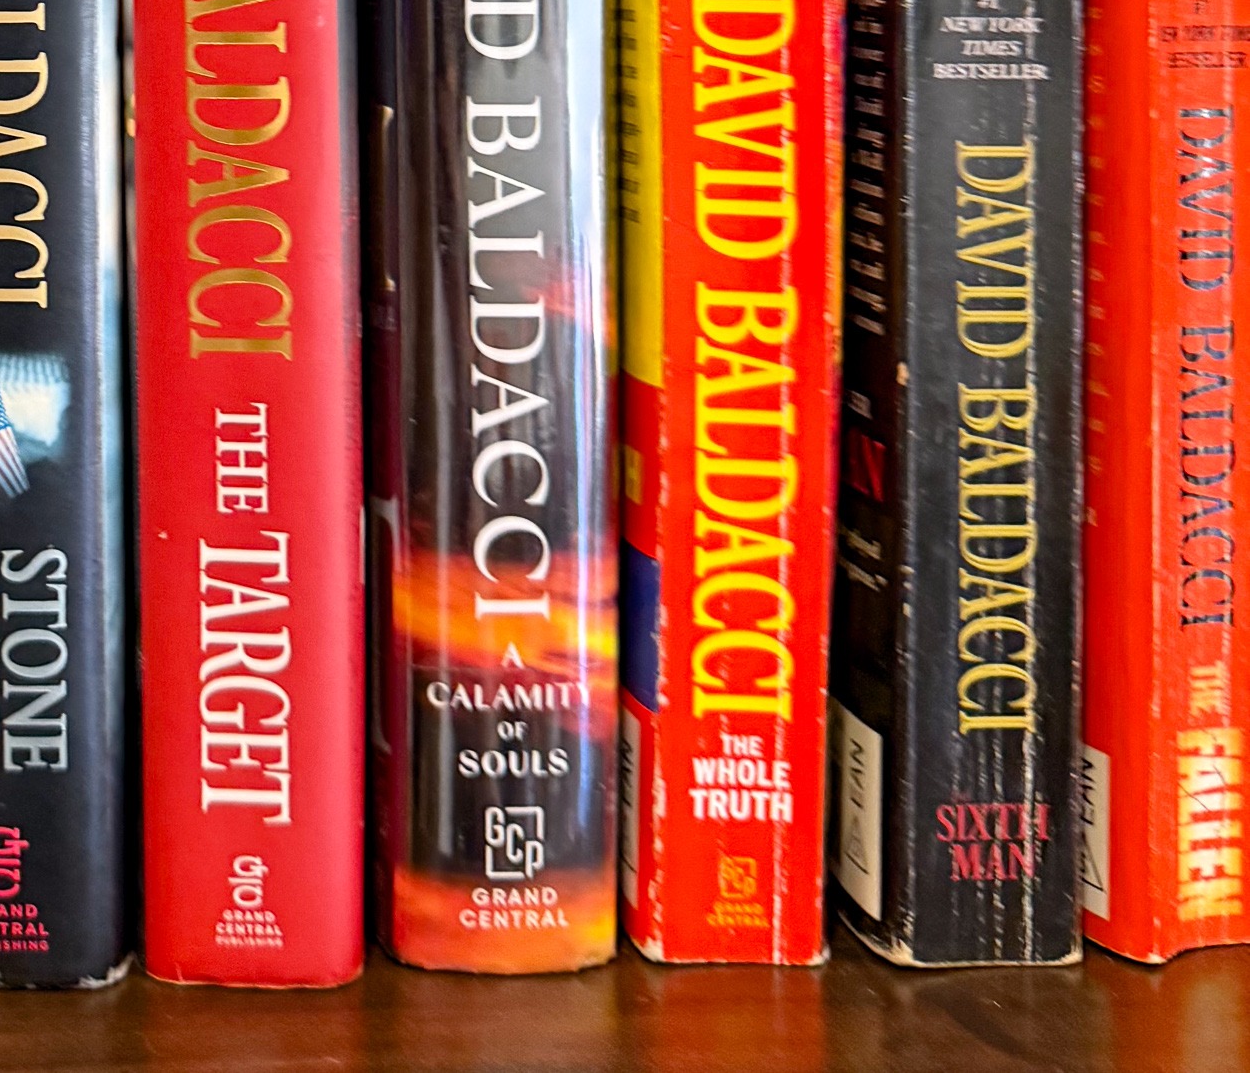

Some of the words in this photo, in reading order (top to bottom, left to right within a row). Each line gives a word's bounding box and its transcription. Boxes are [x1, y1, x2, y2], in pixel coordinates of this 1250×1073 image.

[961, 39, 1024, 56] TIMES
[933, 63, 1049, 80] BESTSELLER
[1178, 104, 1235, 292] DAVID
[955, 140, 1036, 359] DAVID
[466, 95, 550, 621] BALDACCI
[215, 402, 269, 514] THE
[1178, 320, 1236, 631] BALDACCI
[692, 282, 799, 722] BALDACCI
[956, 383, 1038, 735] BALDACCI
[0, 548, 68, 772] STONE
[501, 642, 524, 669] A
[199, 530, 292, 826] TARGET
[426, 682, 590, 712] CALAMITY
[1189, 661, 1230, 718] THE
[497, 721, 528, 741] OF
[721, 733, 764, 758] THE
[458, 749, 569, 778] SOULS
[692, 758, 791, 789] WHOLE
[689, 789, 793, 823] TRUTH
[935, 802, 1050, 842] SIXTH
[1176, 727, 1245, 922] FALLEN
[950, 844, 1036, 882] MAN
[472, 887, 558, 906] GRAND
[216, 922, 283, 936] CENTRAL
[460, 908, 569, 929] CENTRAL
